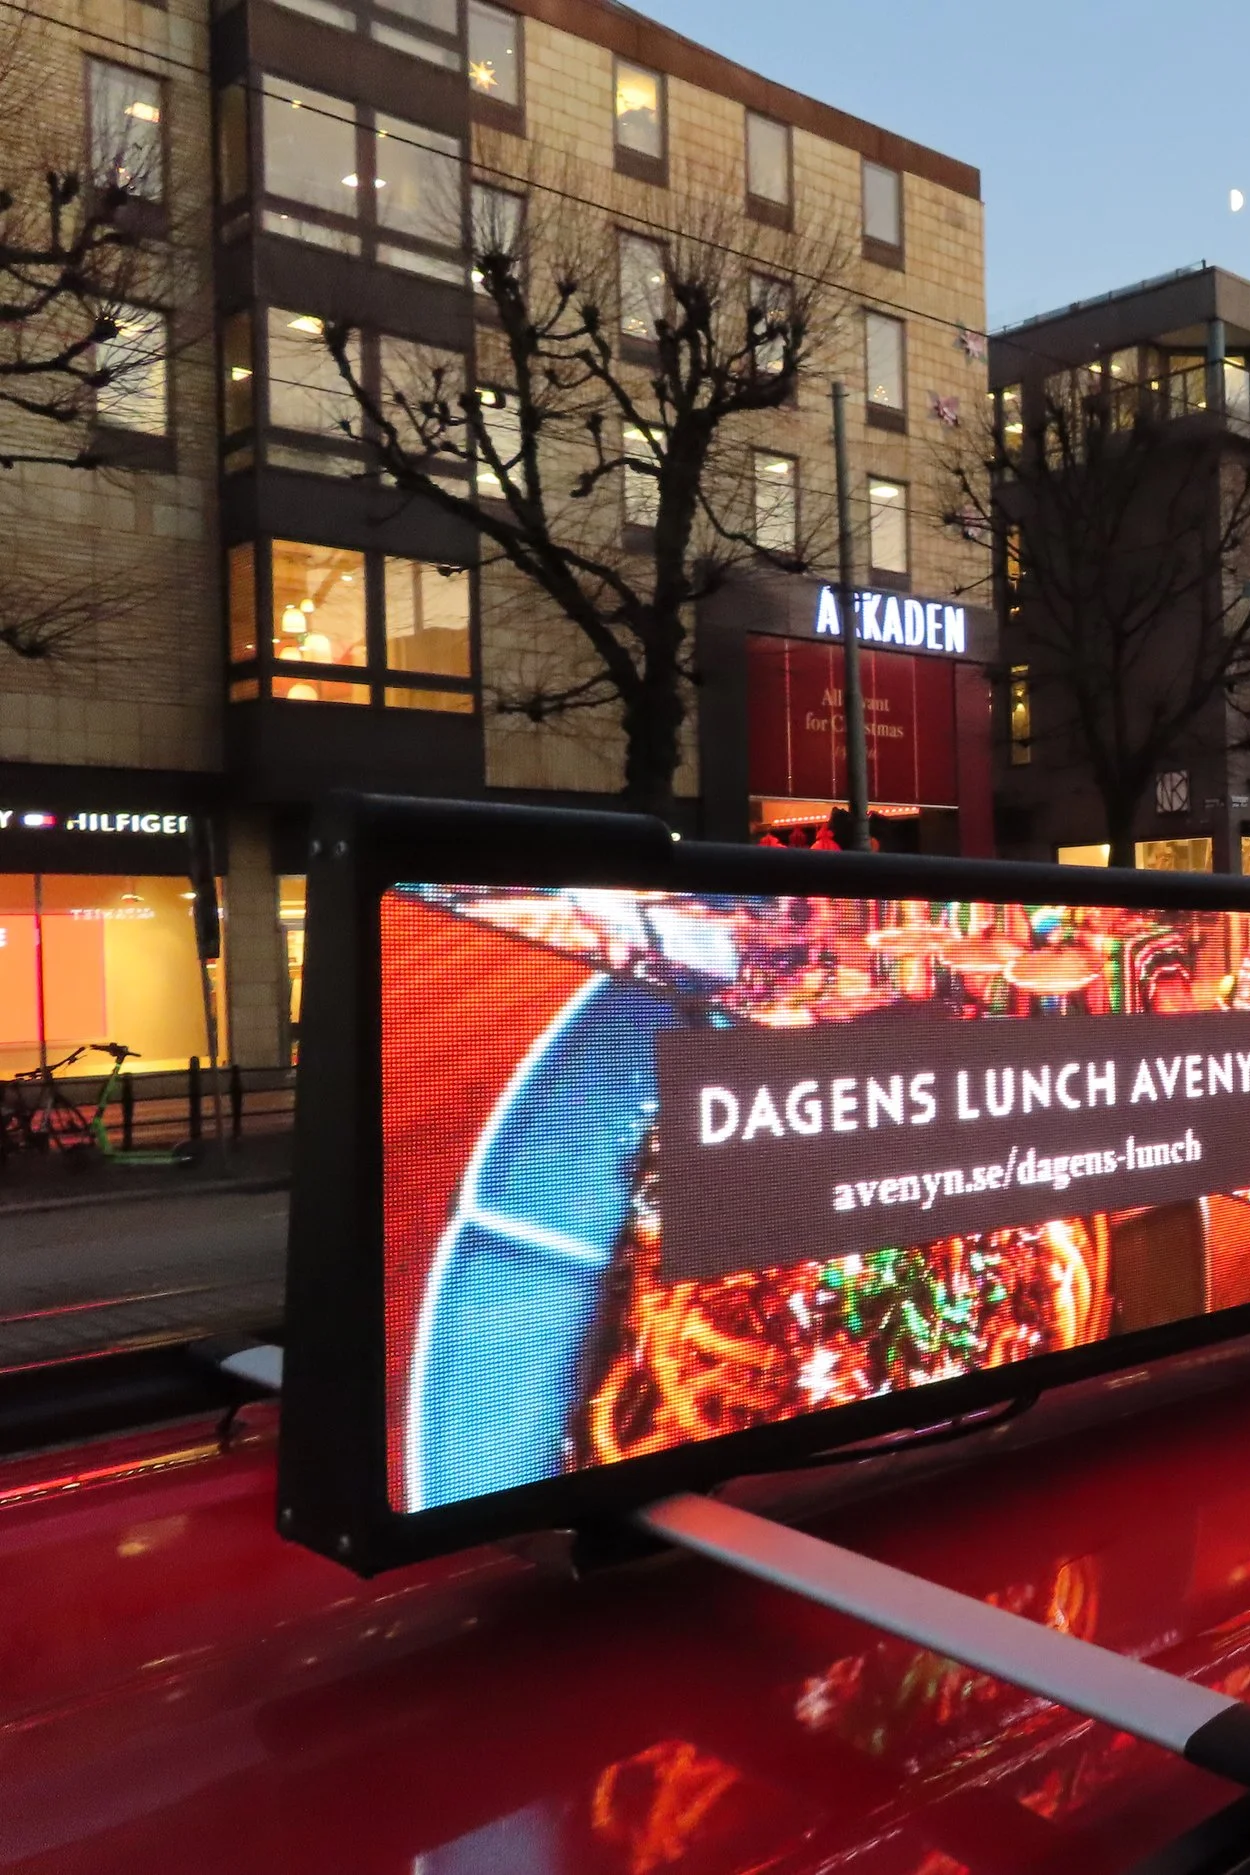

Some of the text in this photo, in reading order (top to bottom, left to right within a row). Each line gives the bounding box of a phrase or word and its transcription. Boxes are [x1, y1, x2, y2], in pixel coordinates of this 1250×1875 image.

[805, 712, 904, 738] for Cstmas
[821, 688, 842, 707] All
[699, 1071, 937, 1145] DAGENS
[956, 1060, 1117, 1121] LUNCH
[832, 1127, 1203, 1211] avenyn.se/dagens-lunch
